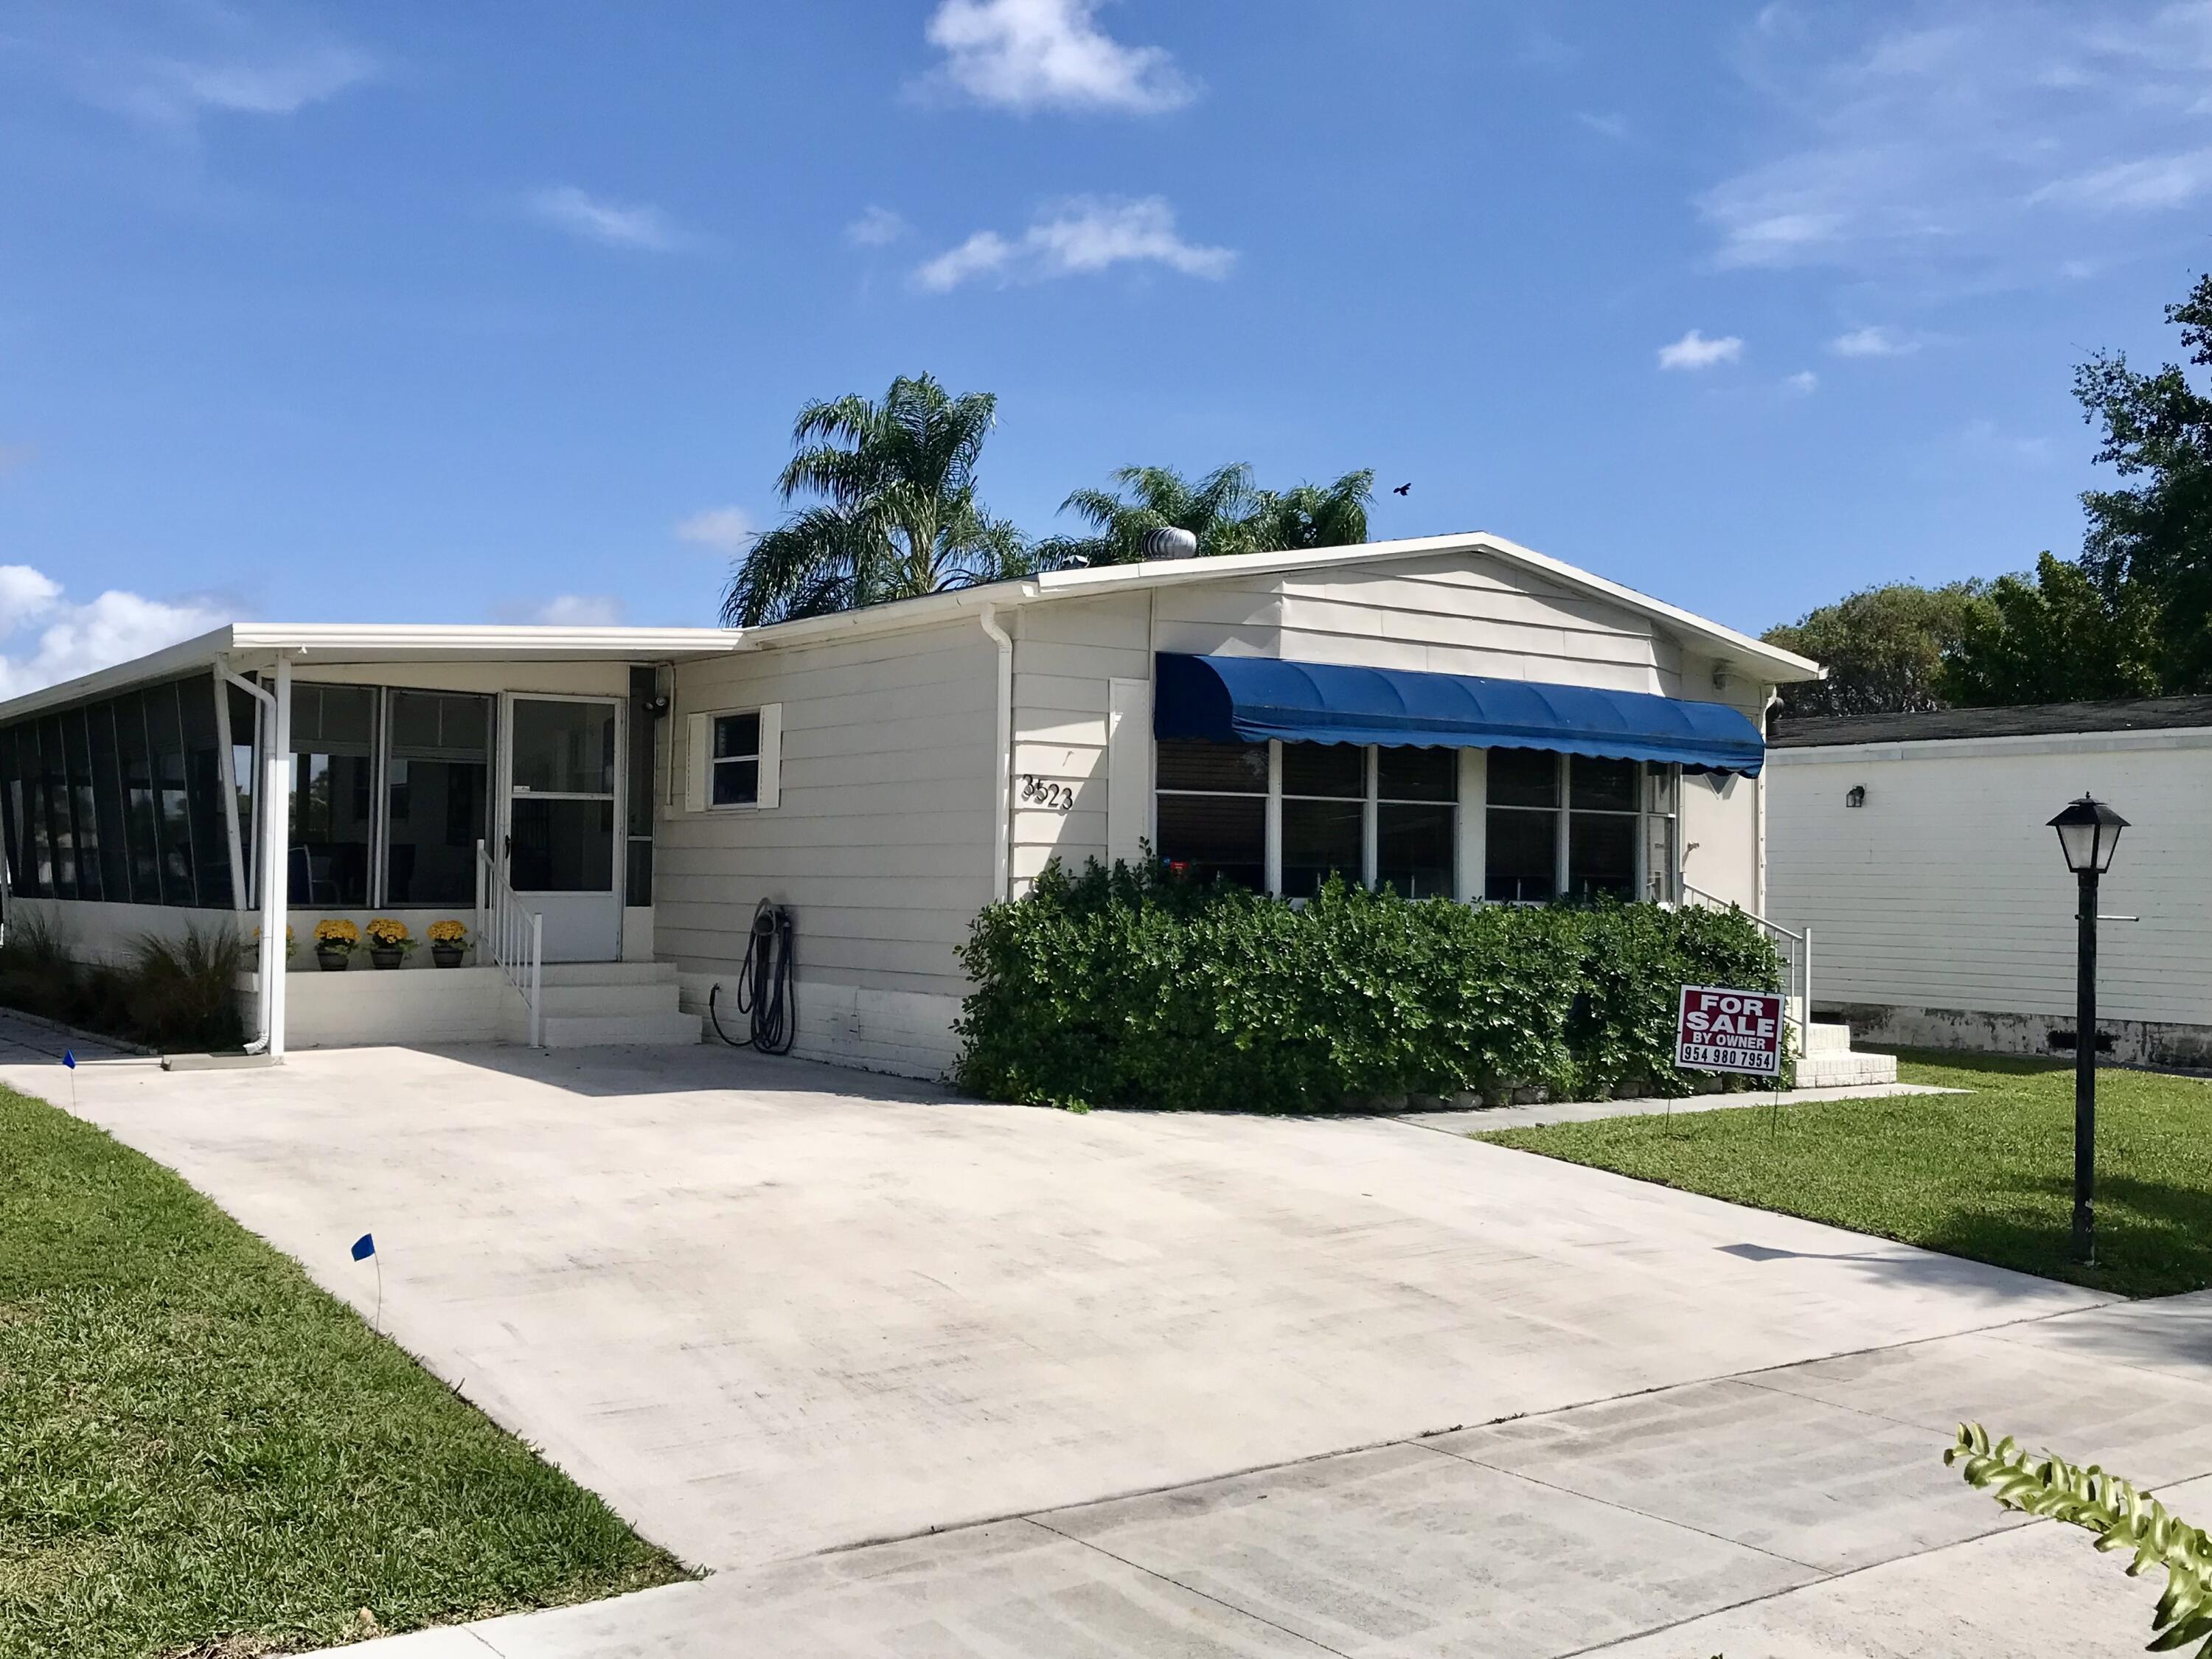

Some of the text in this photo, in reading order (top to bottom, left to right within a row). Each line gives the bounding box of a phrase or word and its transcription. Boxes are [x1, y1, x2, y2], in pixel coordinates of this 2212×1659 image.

[1023, 774, 1073, 810] 3523
[1700, 994, 1764, 1016] FOR
[1686, 1011, 1775, 1038] SALE
[1692, 1032, 1766, 1049] BY OWNER
[1684, 1046, 1770, 1068] 954 980 7954
